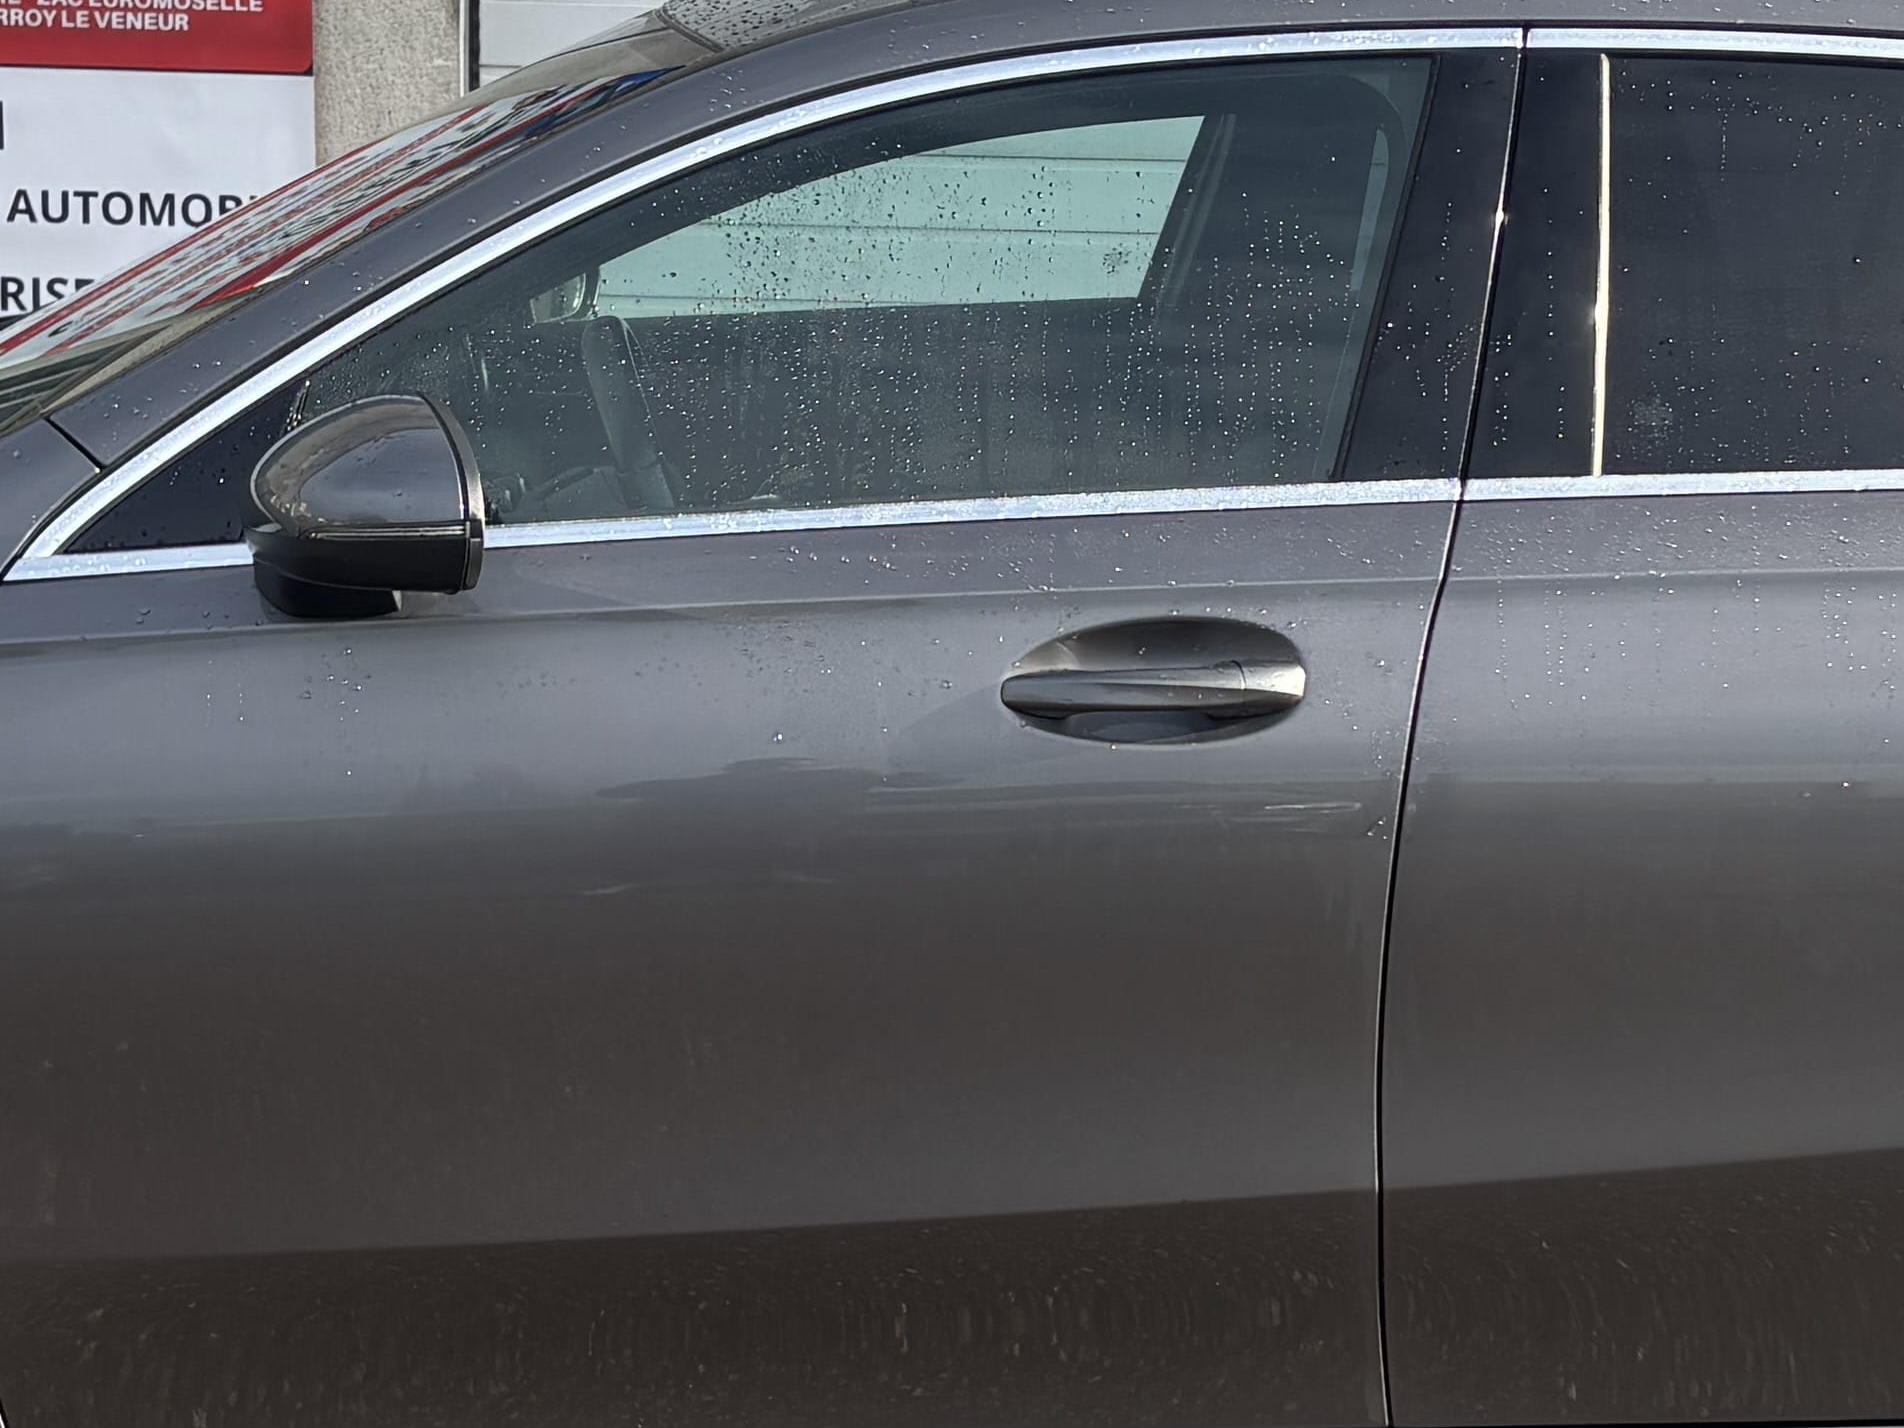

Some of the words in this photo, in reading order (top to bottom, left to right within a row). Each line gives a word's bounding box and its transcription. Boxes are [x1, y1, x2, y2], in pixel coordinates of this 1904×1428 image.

[61, 10, 90, 29] LE
[94, 11, 189, 31] VENEUR
[7, 188, 257, 229] AUTOMO
